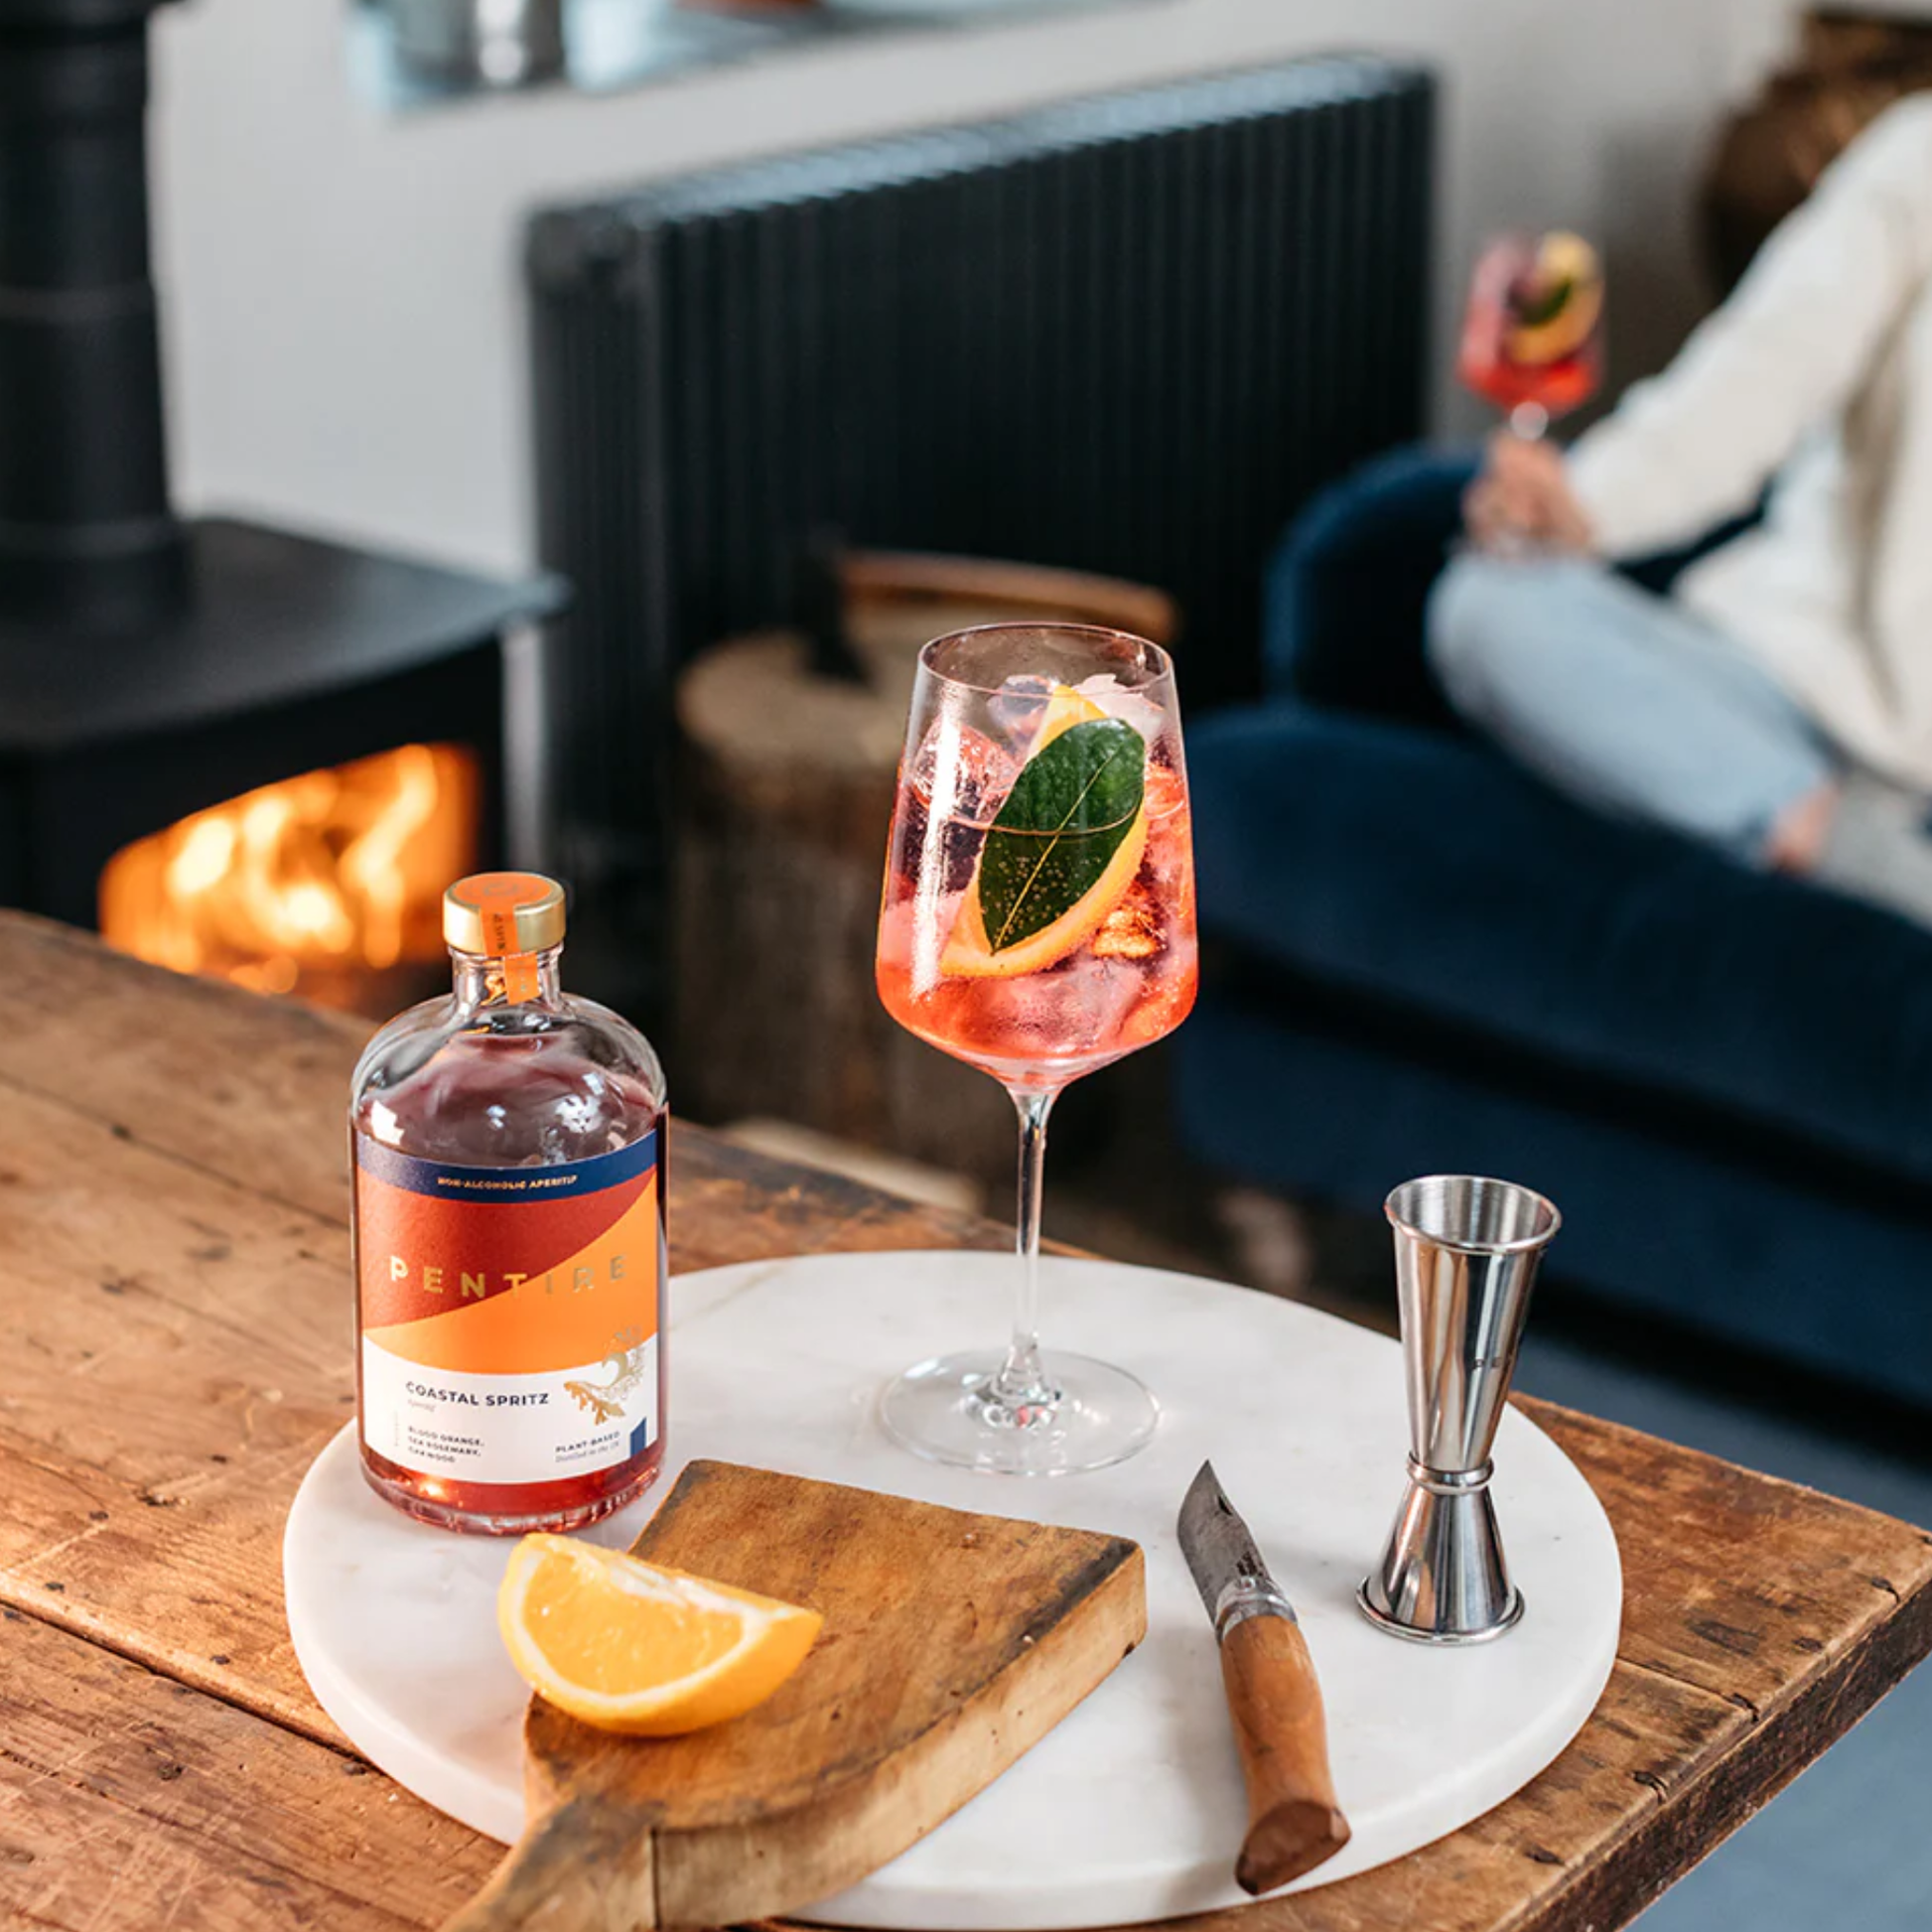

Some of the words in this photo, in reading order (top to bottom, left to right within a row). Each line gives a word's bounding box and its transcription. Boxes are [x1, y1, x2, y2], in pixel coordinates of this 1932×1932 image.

[390, 1255, 627, 1299] PENTIRE
[405, 1381, 480, 1406] COASTAL
[485, 1393, 549, 1406] SPRITZ
